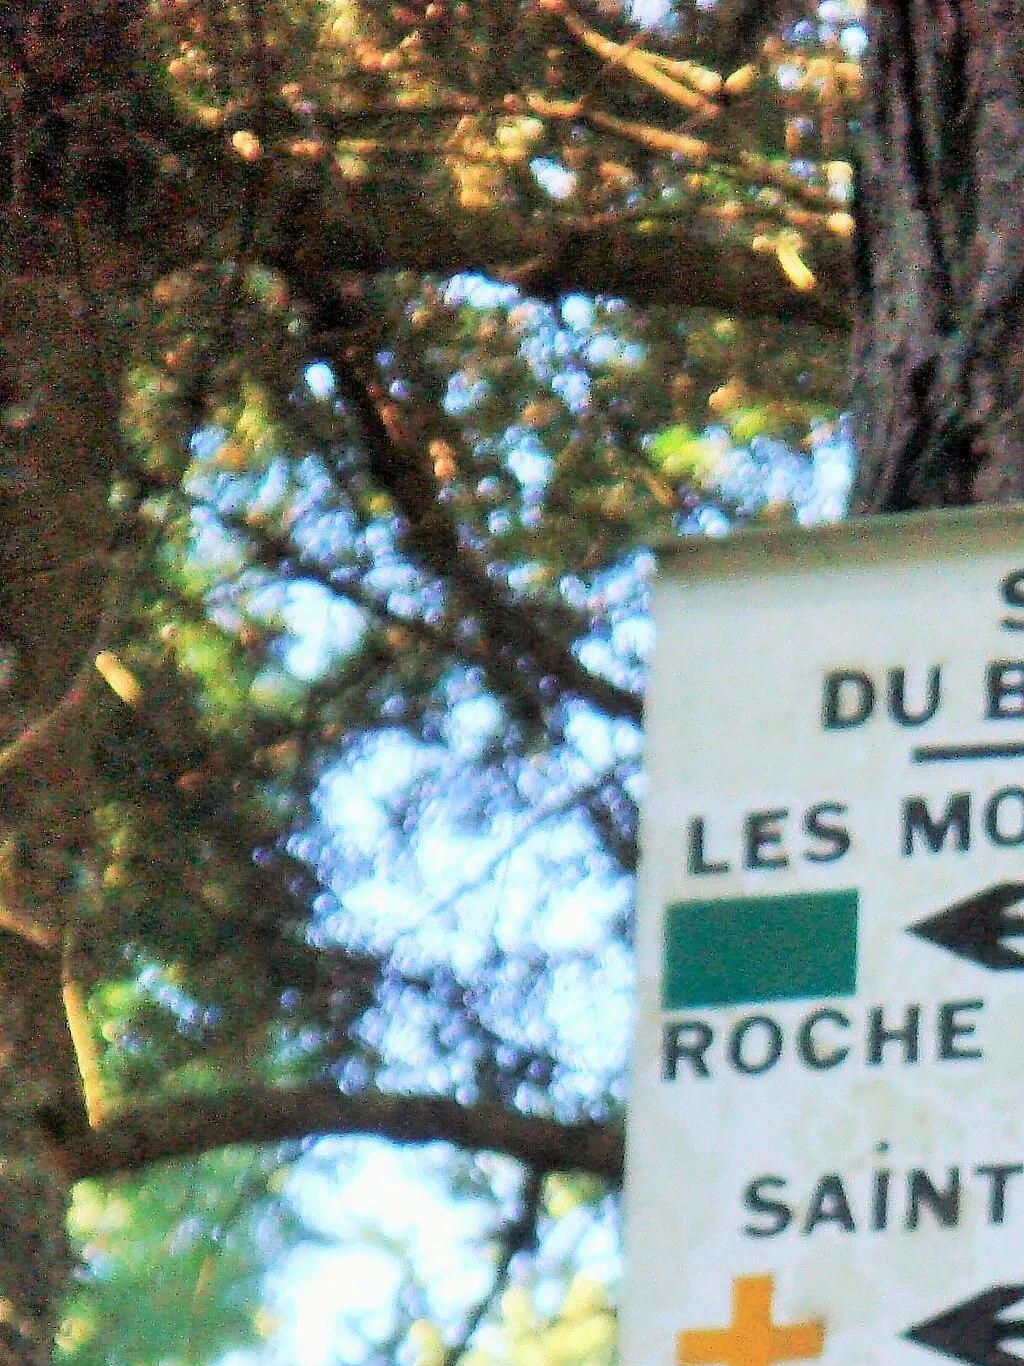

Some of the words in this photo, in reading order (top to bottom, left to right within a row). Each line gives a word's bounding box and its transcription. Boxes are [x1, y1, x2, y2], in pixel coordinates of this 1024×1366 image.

[822, 666, 941, 730] DU
[686, 803, 852, 876] LES
[661, 999, 984, 1081] ROCHE
